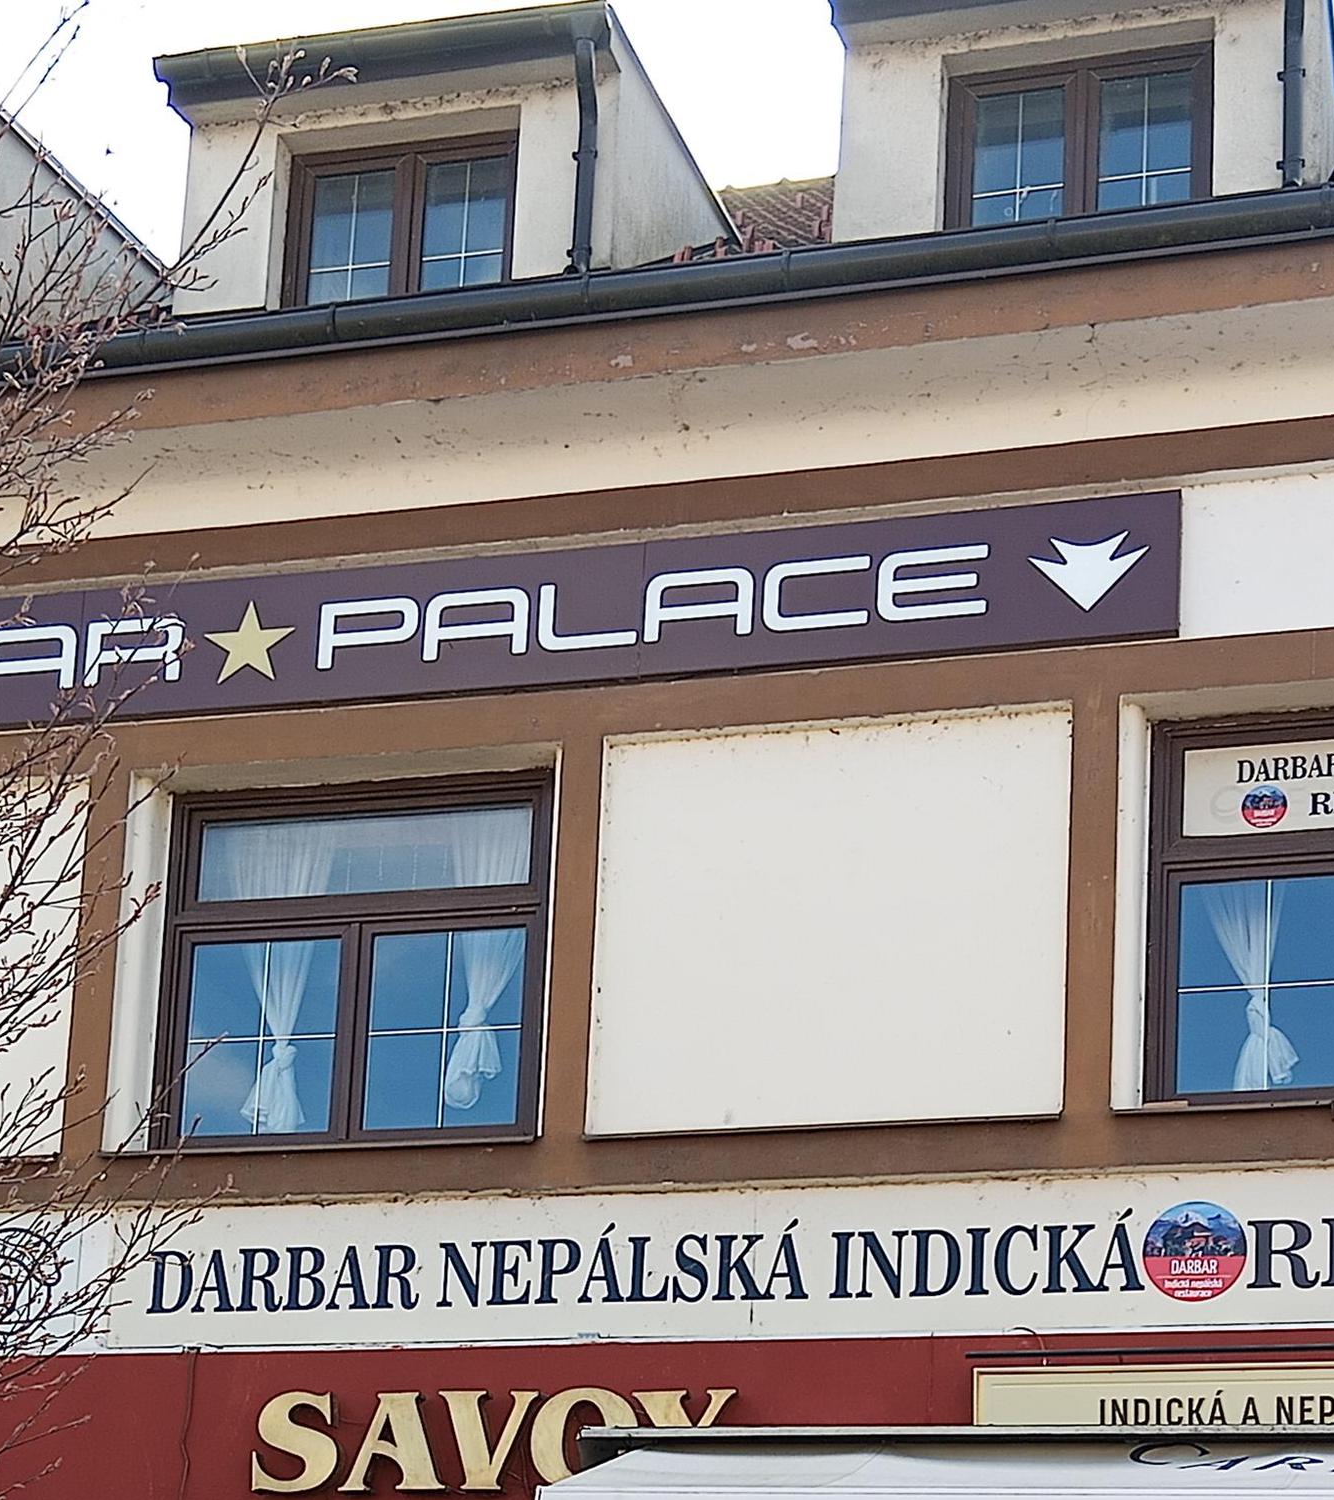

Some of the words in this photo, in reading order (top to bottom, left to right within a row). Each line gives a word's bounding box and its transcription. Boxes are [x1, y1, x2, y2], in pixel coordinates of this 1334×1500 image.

[316, 541, 992, 670] PALACE
[145, 1242, 420, 1315] DARBAR
[437, 1219, 805, 1308] NEPÁLSKÁ
[829, 1207, 1145, 1301] INDICKÁ
[1170, 1259, 1218, 1275] DARBAR
[1099, 1389, 1227, 1426] INDICKÁ
[1243, 1396, 1264, 1426] A
